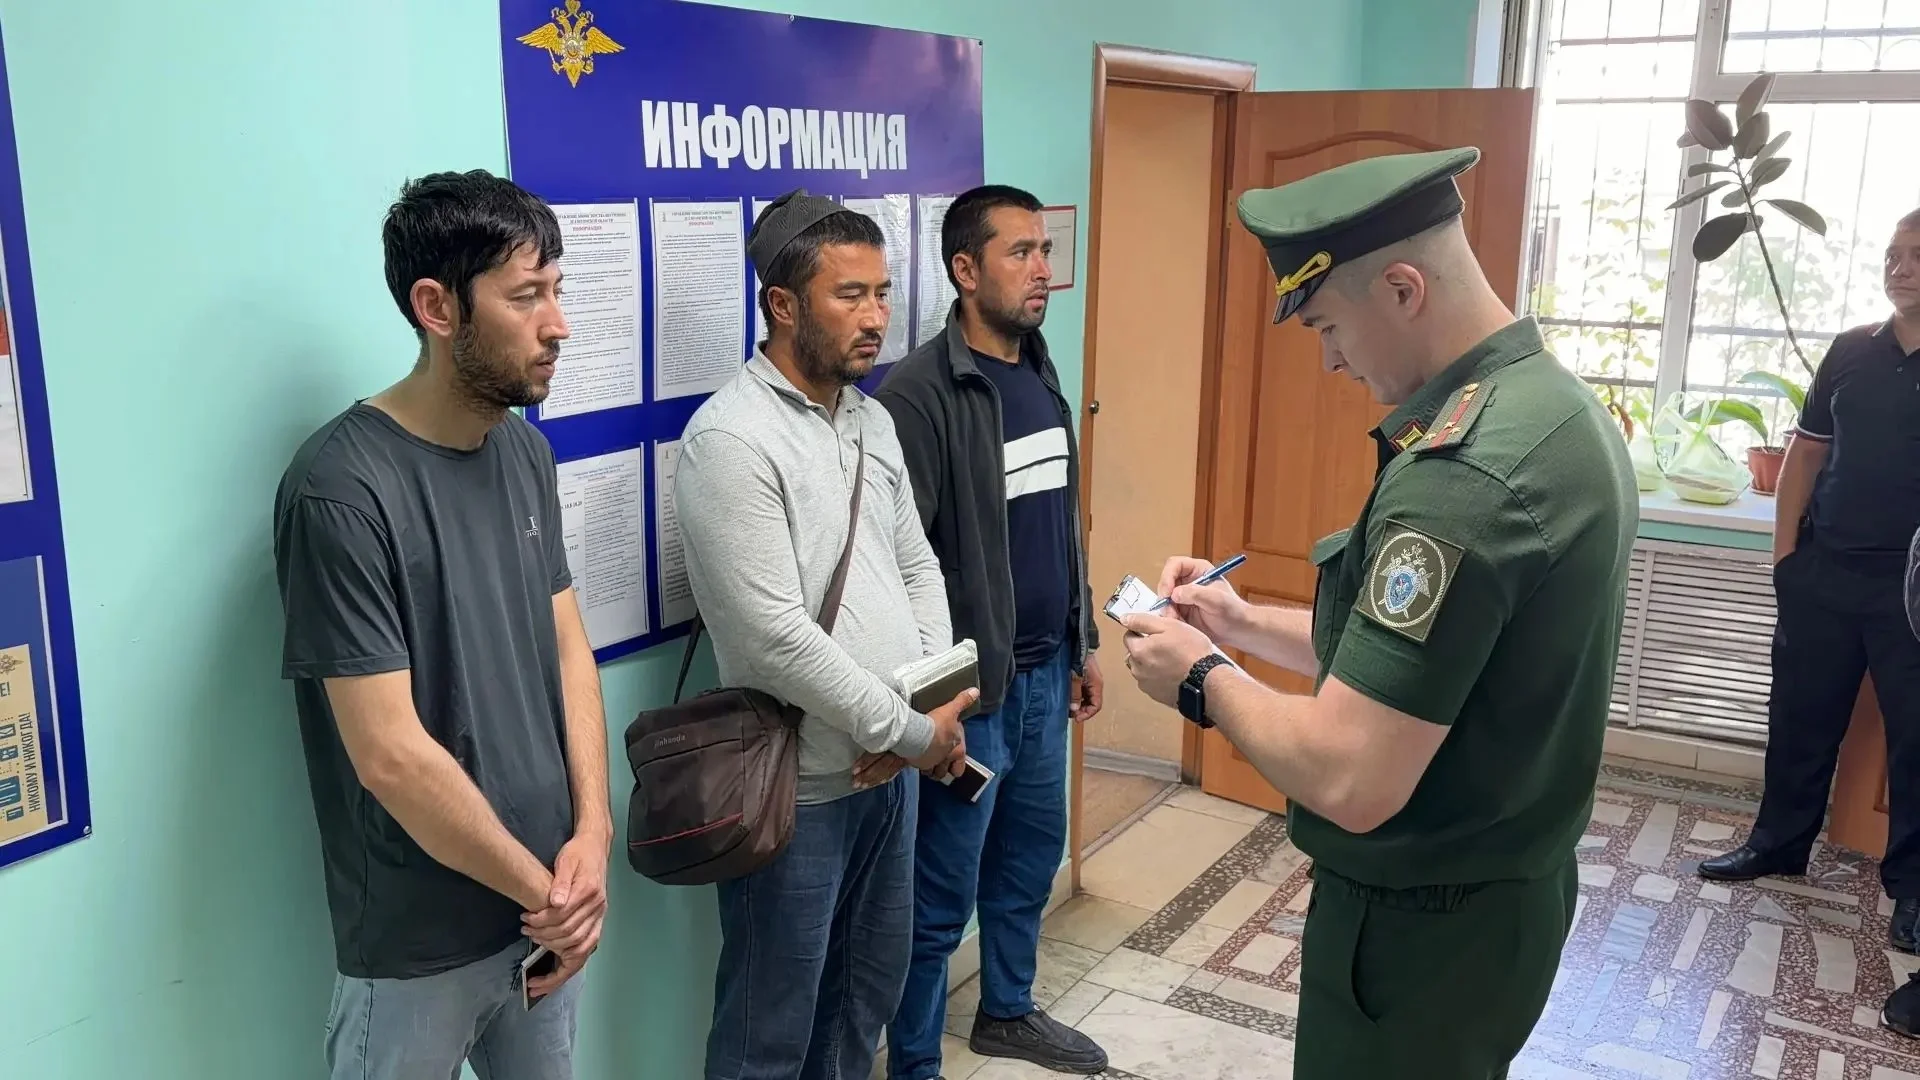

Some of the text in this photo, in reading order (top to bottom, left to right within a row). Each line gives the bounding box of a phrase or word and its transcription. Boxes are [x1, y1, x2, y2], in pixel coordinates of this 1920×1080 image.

[641, 100, 907, 179] ИНФОРМАЦИЯ
[24, 762, 37, 771] И
[25, 772, 41, 812] НИКОМУ
